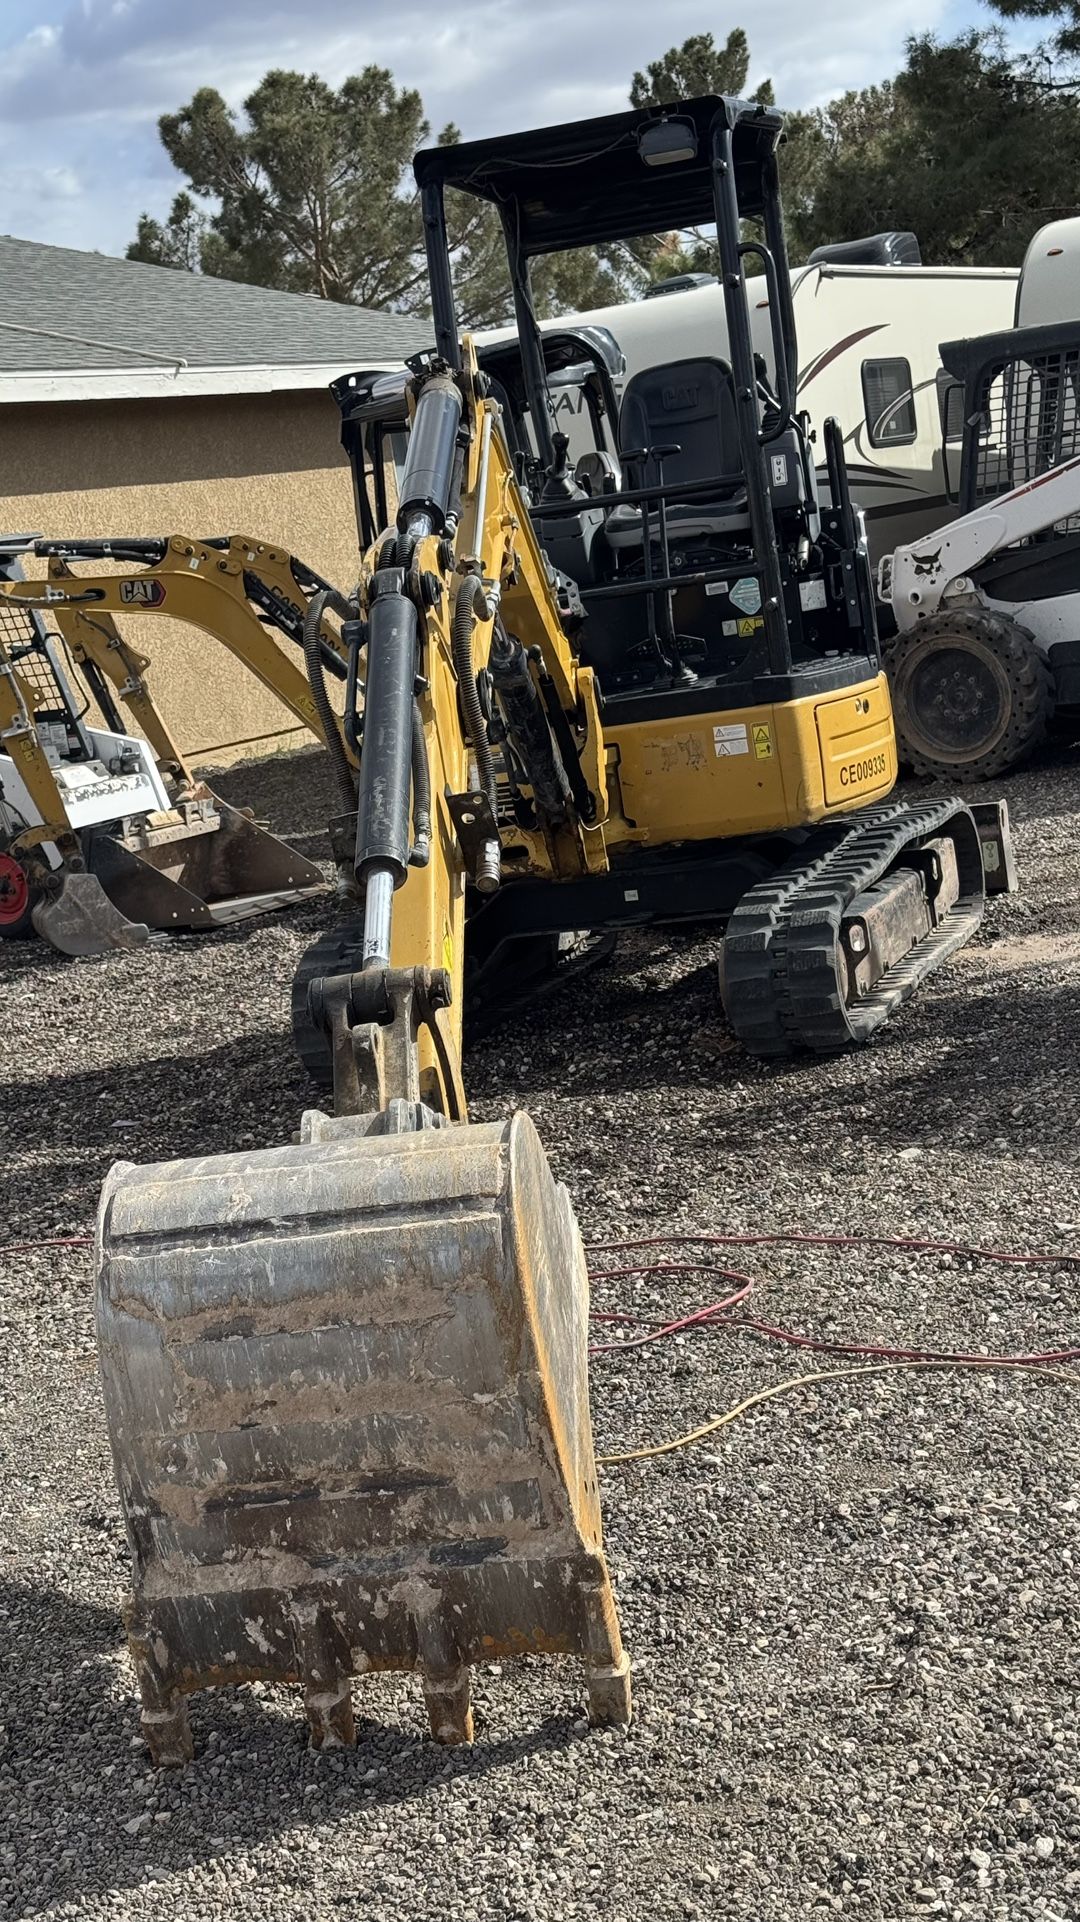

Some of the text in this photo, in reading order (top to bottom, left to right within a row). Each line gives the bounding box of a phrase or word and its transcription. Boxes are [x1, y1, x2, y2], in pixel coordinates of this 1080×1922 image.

[662, 384, 699, 411] CAT
[120, 580, 155, 603] CAT
[839, 753, 886, 786] CE009335
